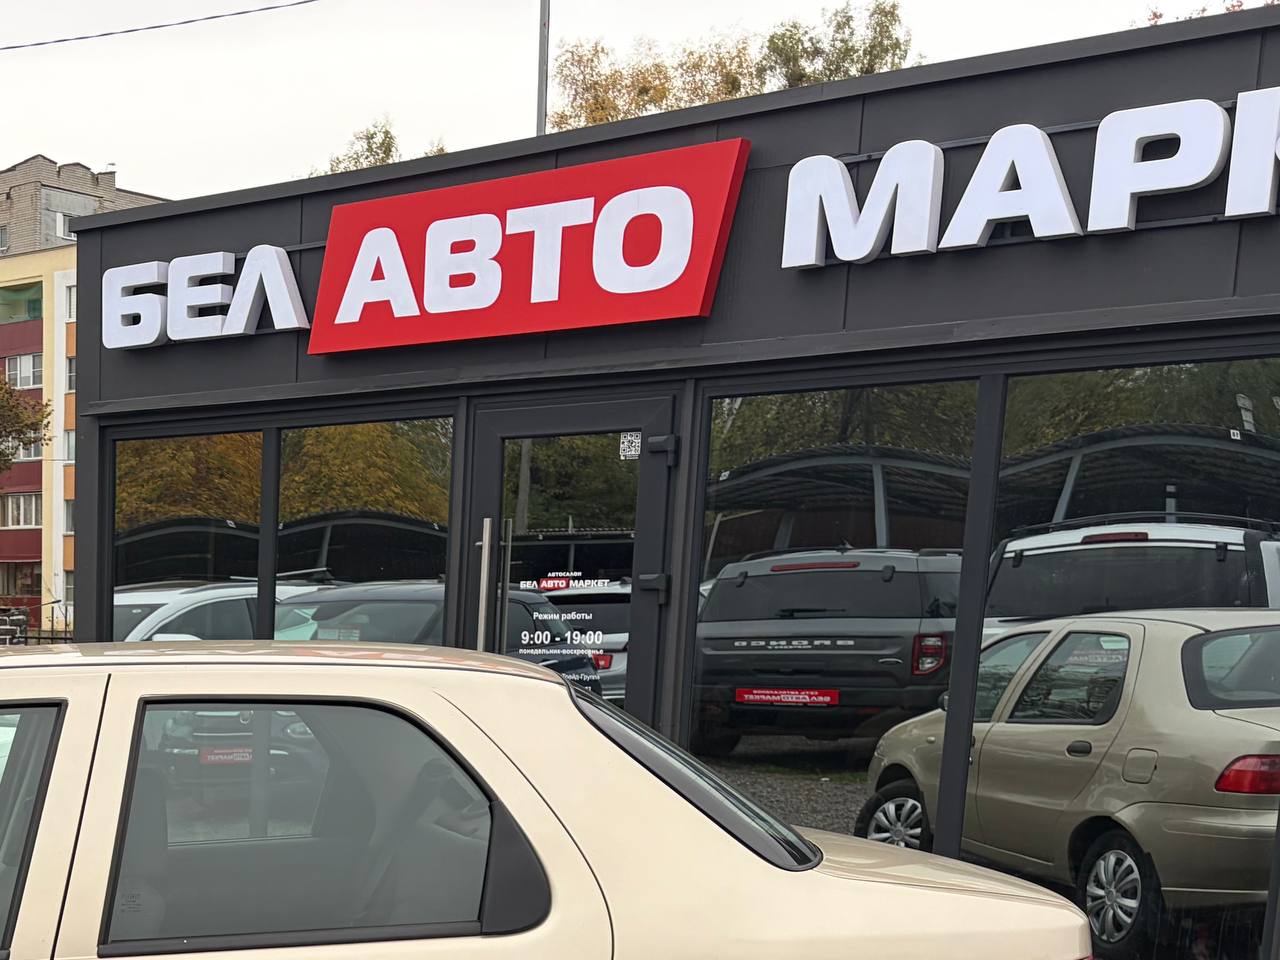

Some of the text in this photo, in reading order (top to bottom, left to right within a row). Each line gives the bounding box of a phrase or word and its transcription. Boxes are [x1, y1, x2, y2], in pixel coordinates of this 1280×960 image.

[102, 244, 310, 349] БЕЛ
[334, 185, 694, 324] АВТО
[570, 579, 610, 588] МАРКЕТ
[533, 611, 593, 621] Режим работы
[521, 631, 551, 644] 9:00
[565, 631, 603, 644] 19:00
